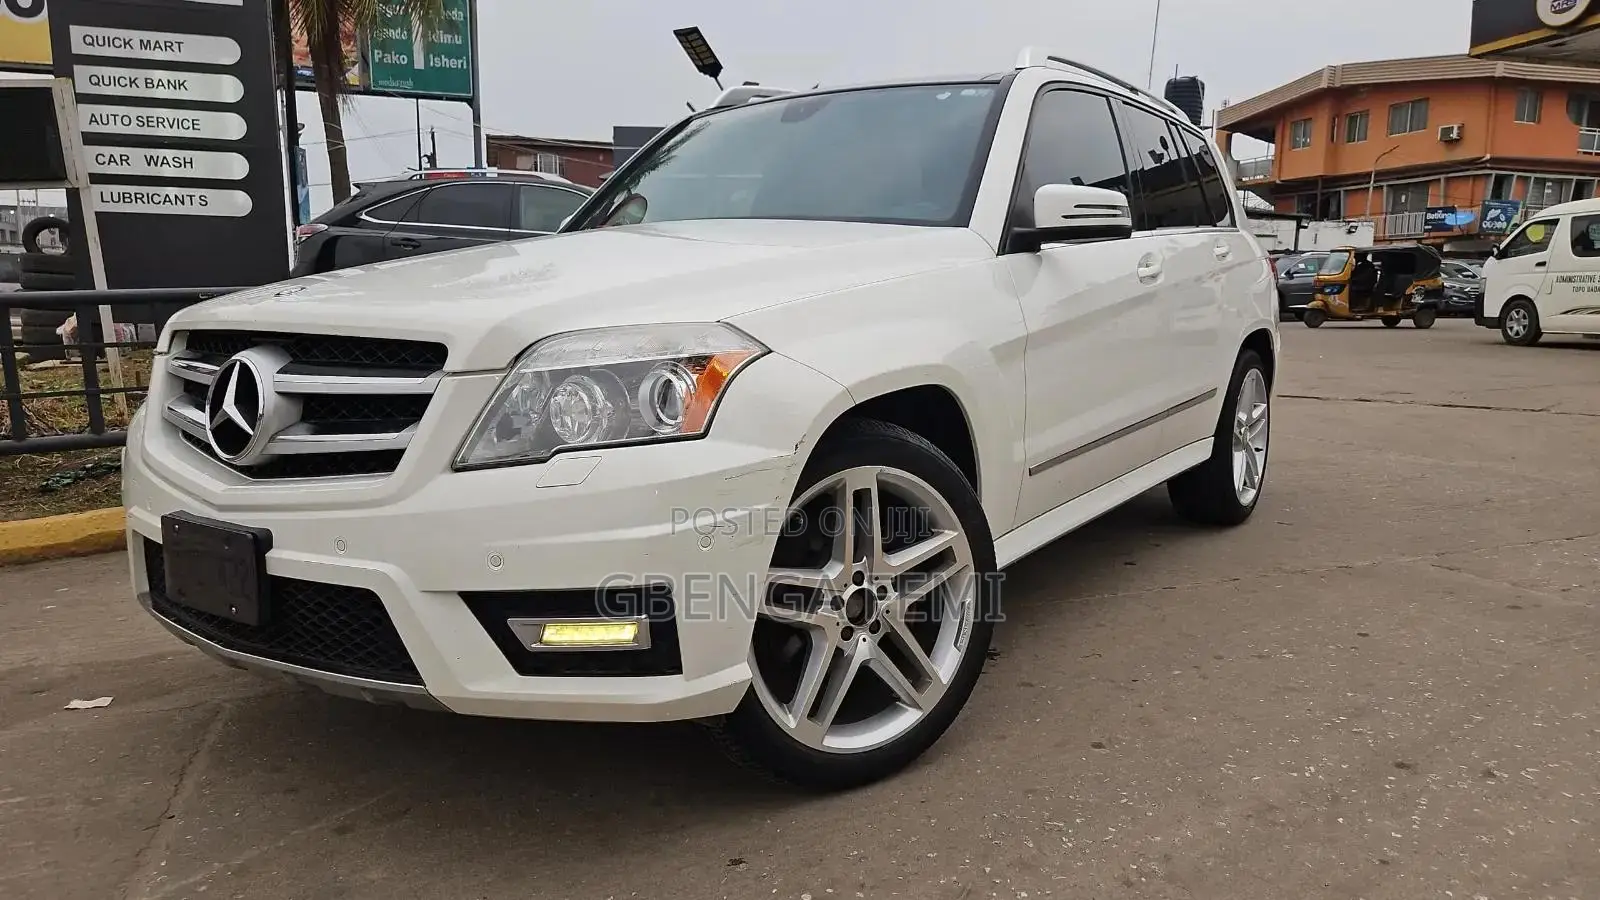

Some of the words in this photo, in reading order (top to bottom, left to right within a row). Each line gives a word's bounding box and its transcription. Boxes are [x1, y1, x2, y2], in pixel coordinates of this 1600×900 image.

[83, 34, 134, 50] QUICK
[139, 39, 184, 53] MART
[374, 49, 408, 65] Pako
[429, 53, 467, 69] Isheri
[88, 74, 140, 90] QUICK
[144, 78, 188, 91] BANK
[88, 113, 132, 127] AUTO
[136, 115, 201, 131] SERVICE
[95, 153, 131, 167] CAR
[144, 154, 194, 169] WASH
[100, 191, 209, 207] LUBRICANTS
